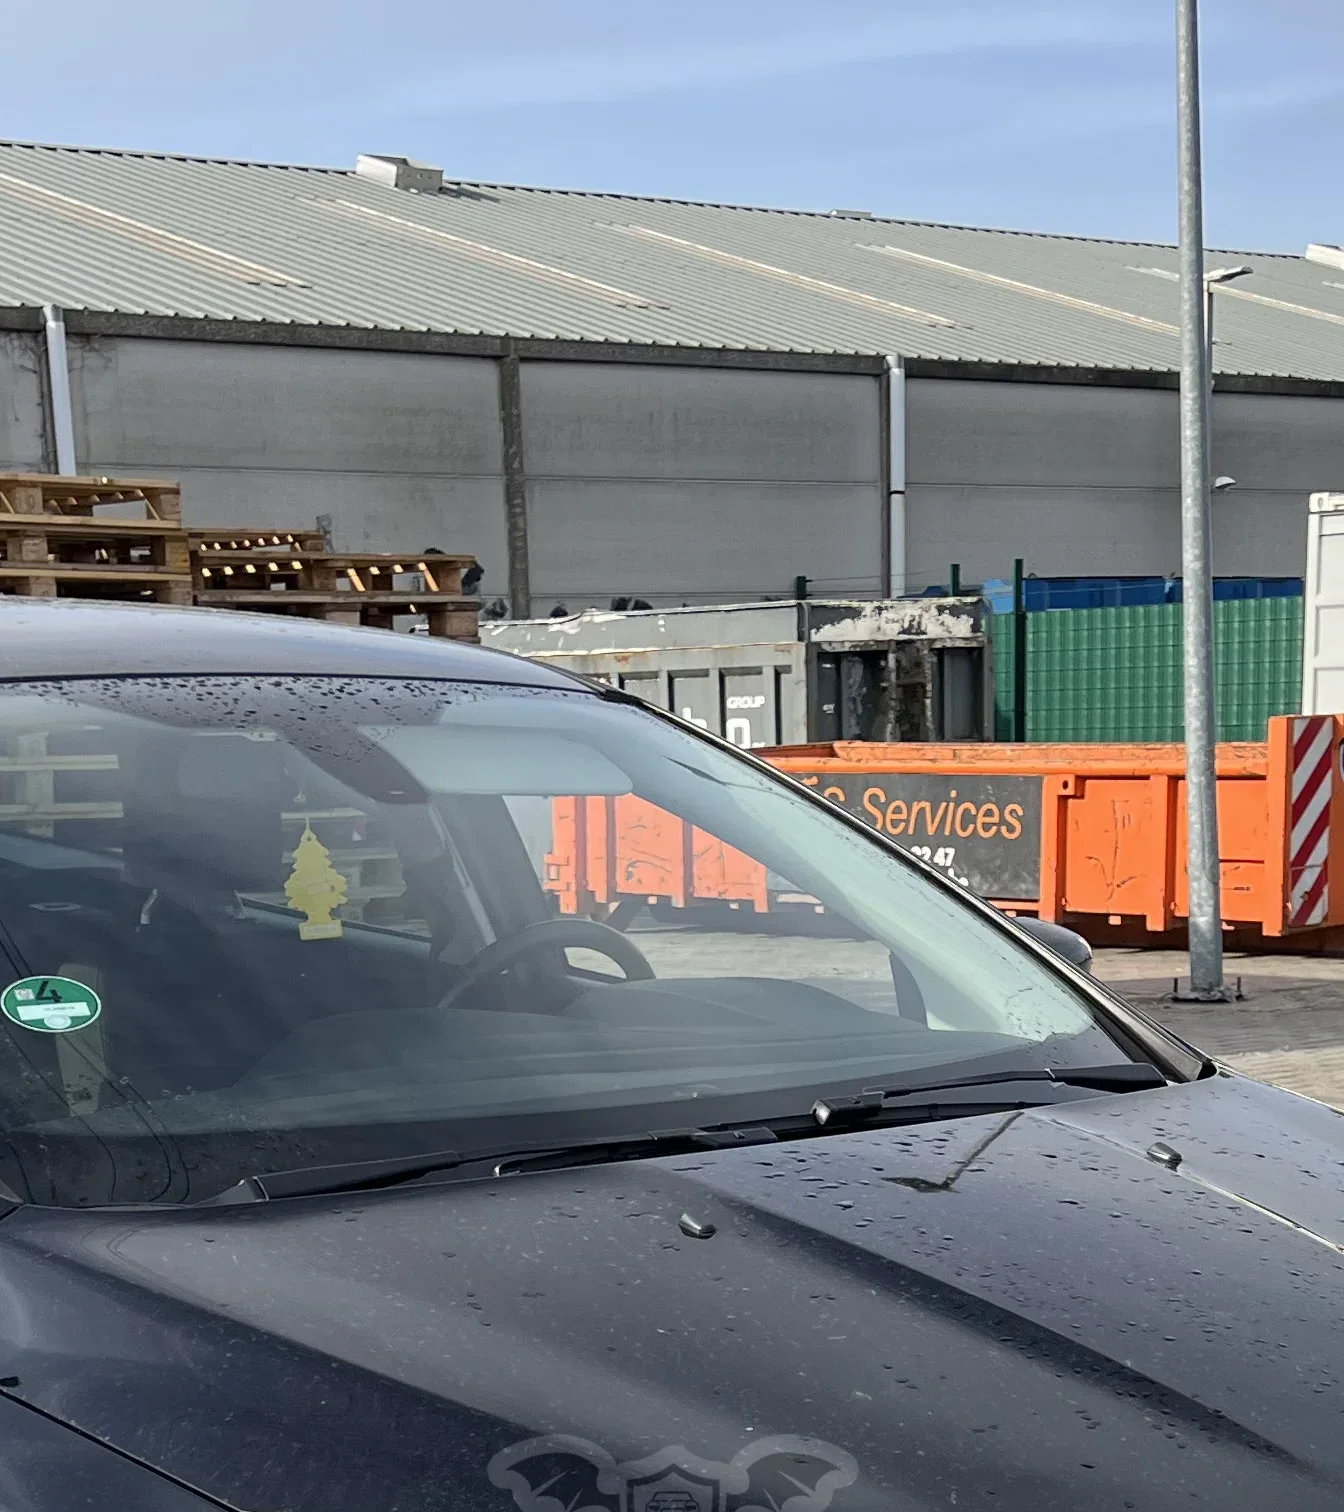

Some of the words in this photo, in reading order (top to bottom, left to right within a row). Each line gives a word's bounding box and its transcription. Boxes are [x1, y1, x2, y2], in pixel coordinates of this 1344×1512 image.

[726, 695, 765, 709] GROUP
[863, 787, 1024, 840] Services
[35, 980, 63, 1003] 4
